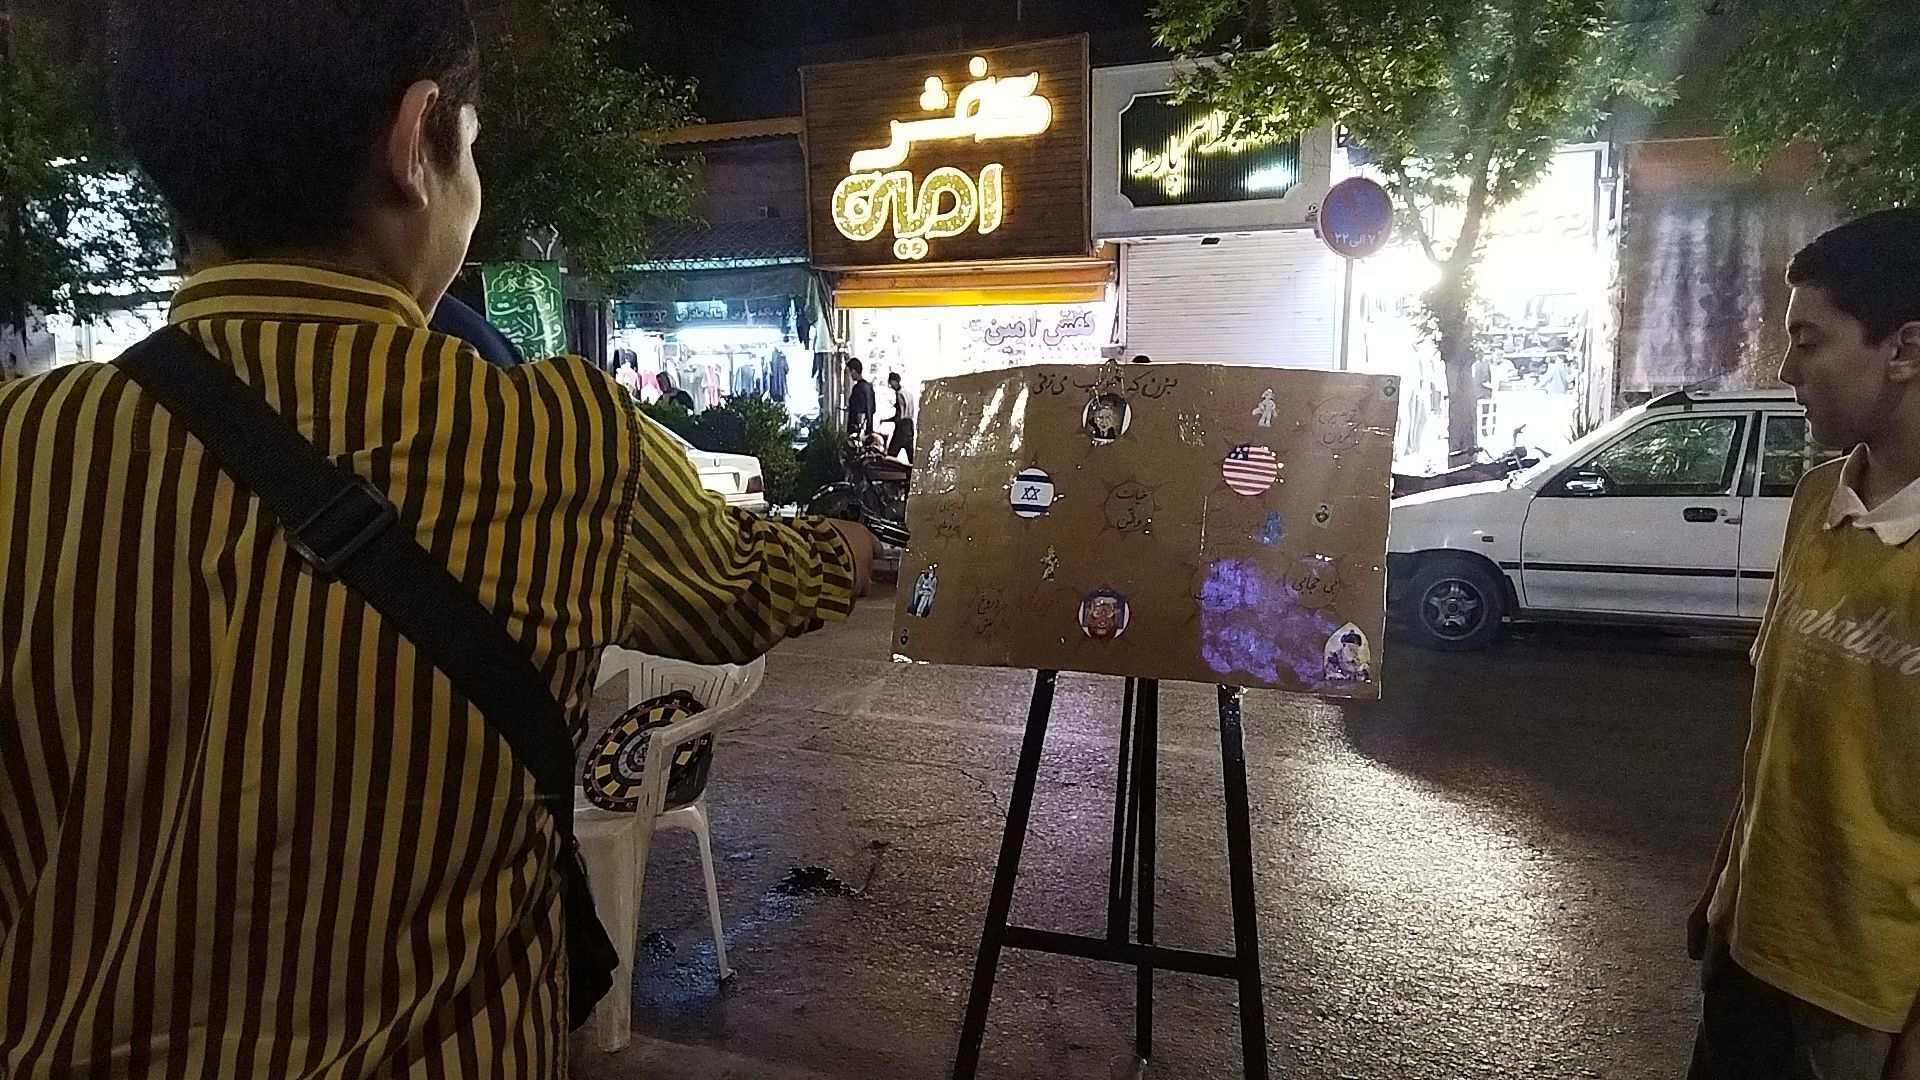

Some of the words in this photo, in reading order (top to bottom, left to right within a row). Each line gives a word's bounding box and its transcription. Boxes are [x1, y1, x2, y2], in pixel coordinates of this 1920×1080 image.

[849, 56, 1052, 174] کفش
[831, 162, 1004, 260] امین
[1042, 305, 1096, 346] کفش
[1073, 368, 1124, 392] خب
[1141, 377, 1178, 399] بزن
